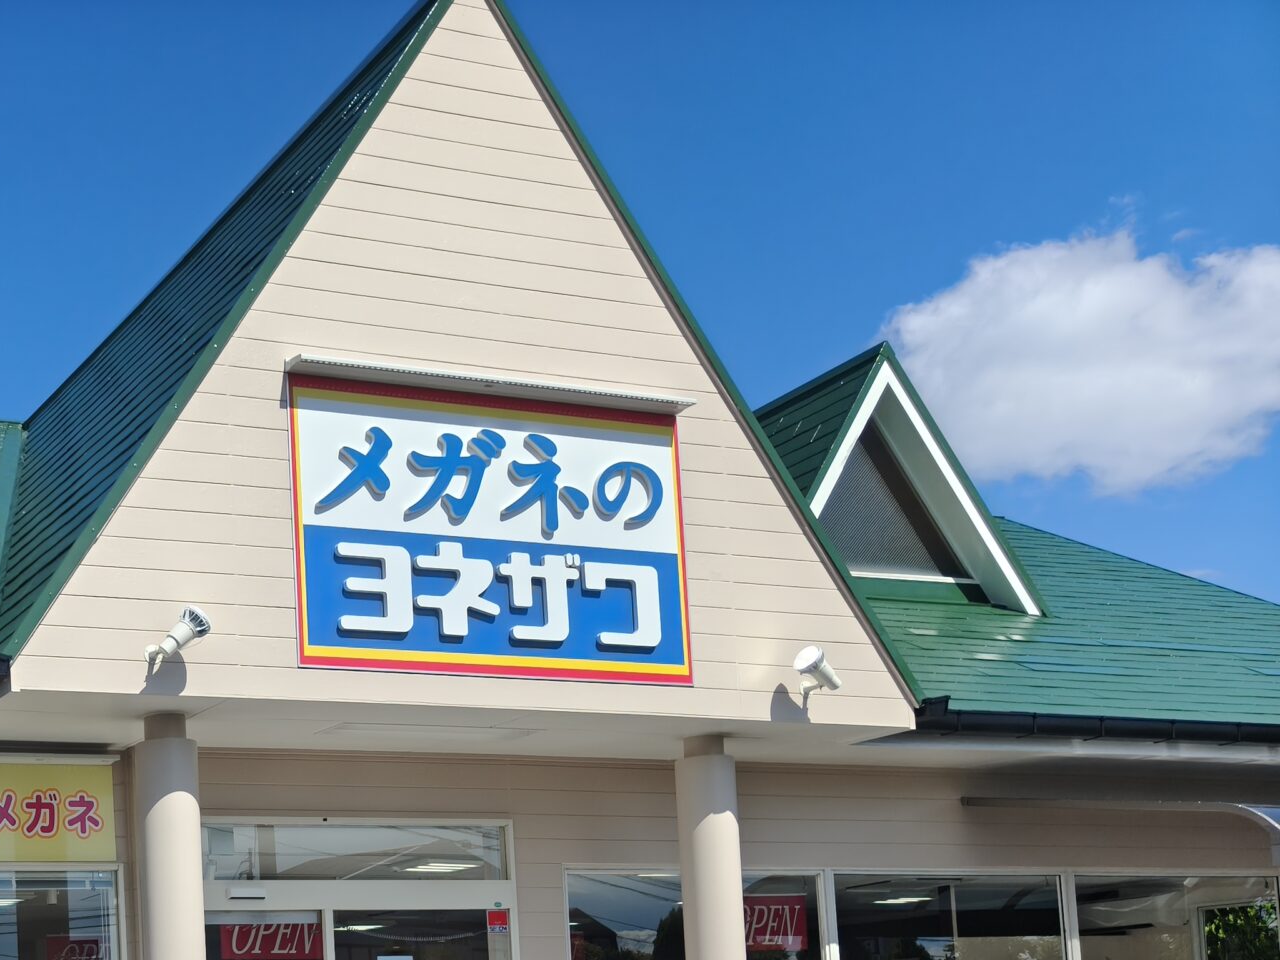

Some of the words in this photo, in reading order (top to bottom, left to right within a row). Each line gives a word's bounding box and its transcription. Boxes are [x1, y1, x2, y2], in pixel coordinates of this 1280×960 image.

[314, 426, 663, 539] メガネの
[334, 541, 662, 649] ヨネザワ
[231, 924, 317, 955] OPEN
